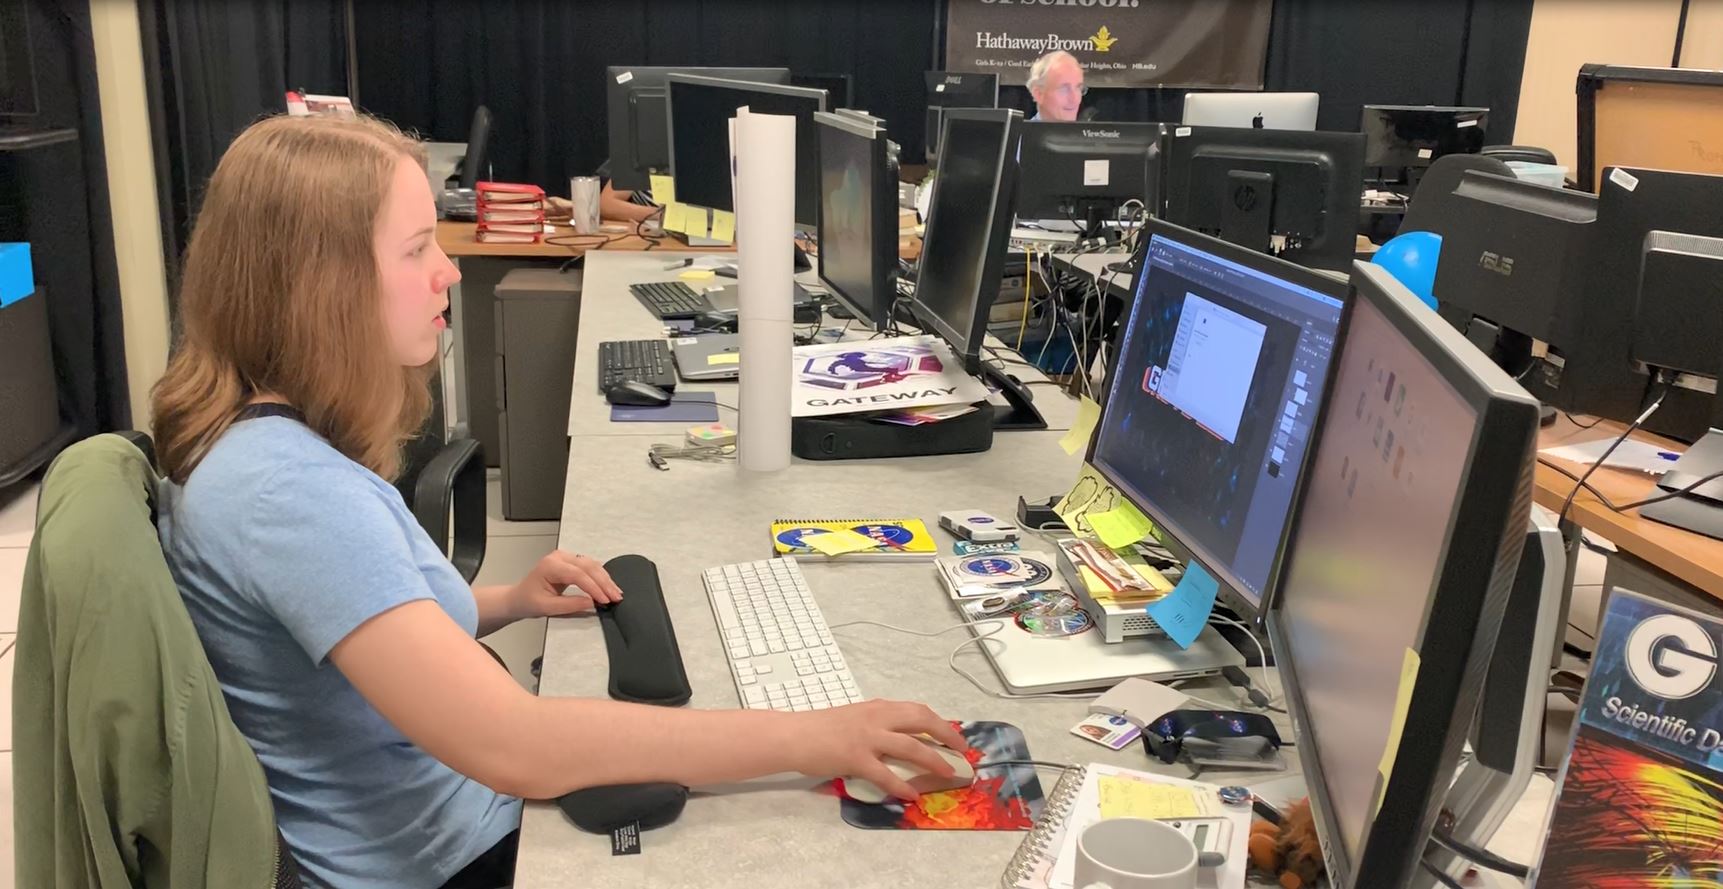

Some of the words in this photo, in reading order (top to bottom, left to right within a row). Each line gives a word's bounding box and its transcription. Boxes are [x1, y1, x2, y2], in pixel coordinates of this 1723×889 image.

[1082, 129, 1120, 139] ViewSonic
[806, 387, 957, 407] GATEWAY
[1625, 613, 1717, 699] G
[1601, 696, 1697, 745] Scientific
